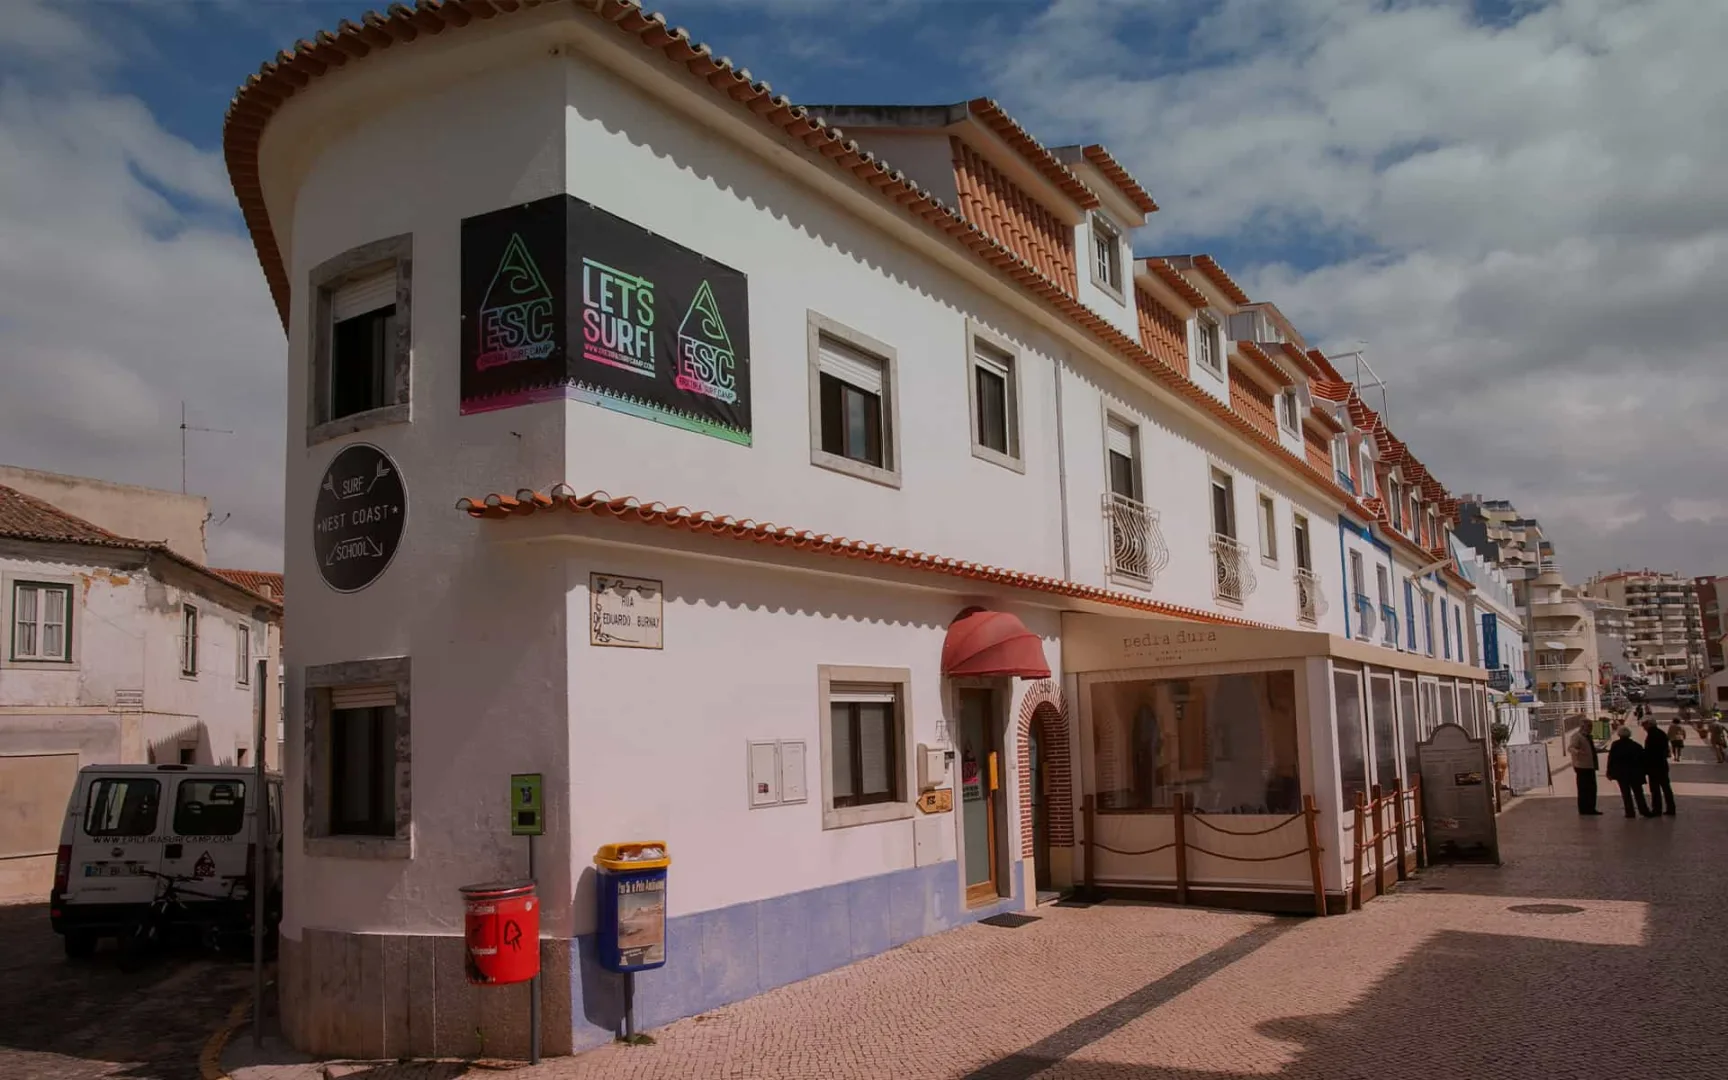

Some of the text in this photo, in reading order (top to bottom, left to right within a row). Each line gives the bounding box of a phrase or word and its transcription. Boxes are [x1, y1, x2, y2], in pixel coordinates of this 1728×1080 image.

[583, 264, 654, 326] LET'S
[479, 298, 554, 352] ESC
[583, 309, 655, 363] SURF!
[678, 334, 735, 390] ESC
[342, 476, 364, 495] SURF
[352, 505, 389, 525] COAST
[336, 541, 369, 561] SCHOOL
[621, 595, 634, 607] RUA
[603, 612, 631, 626] EDUARDO
[1123, 630, 1217, 648] pedra dura
